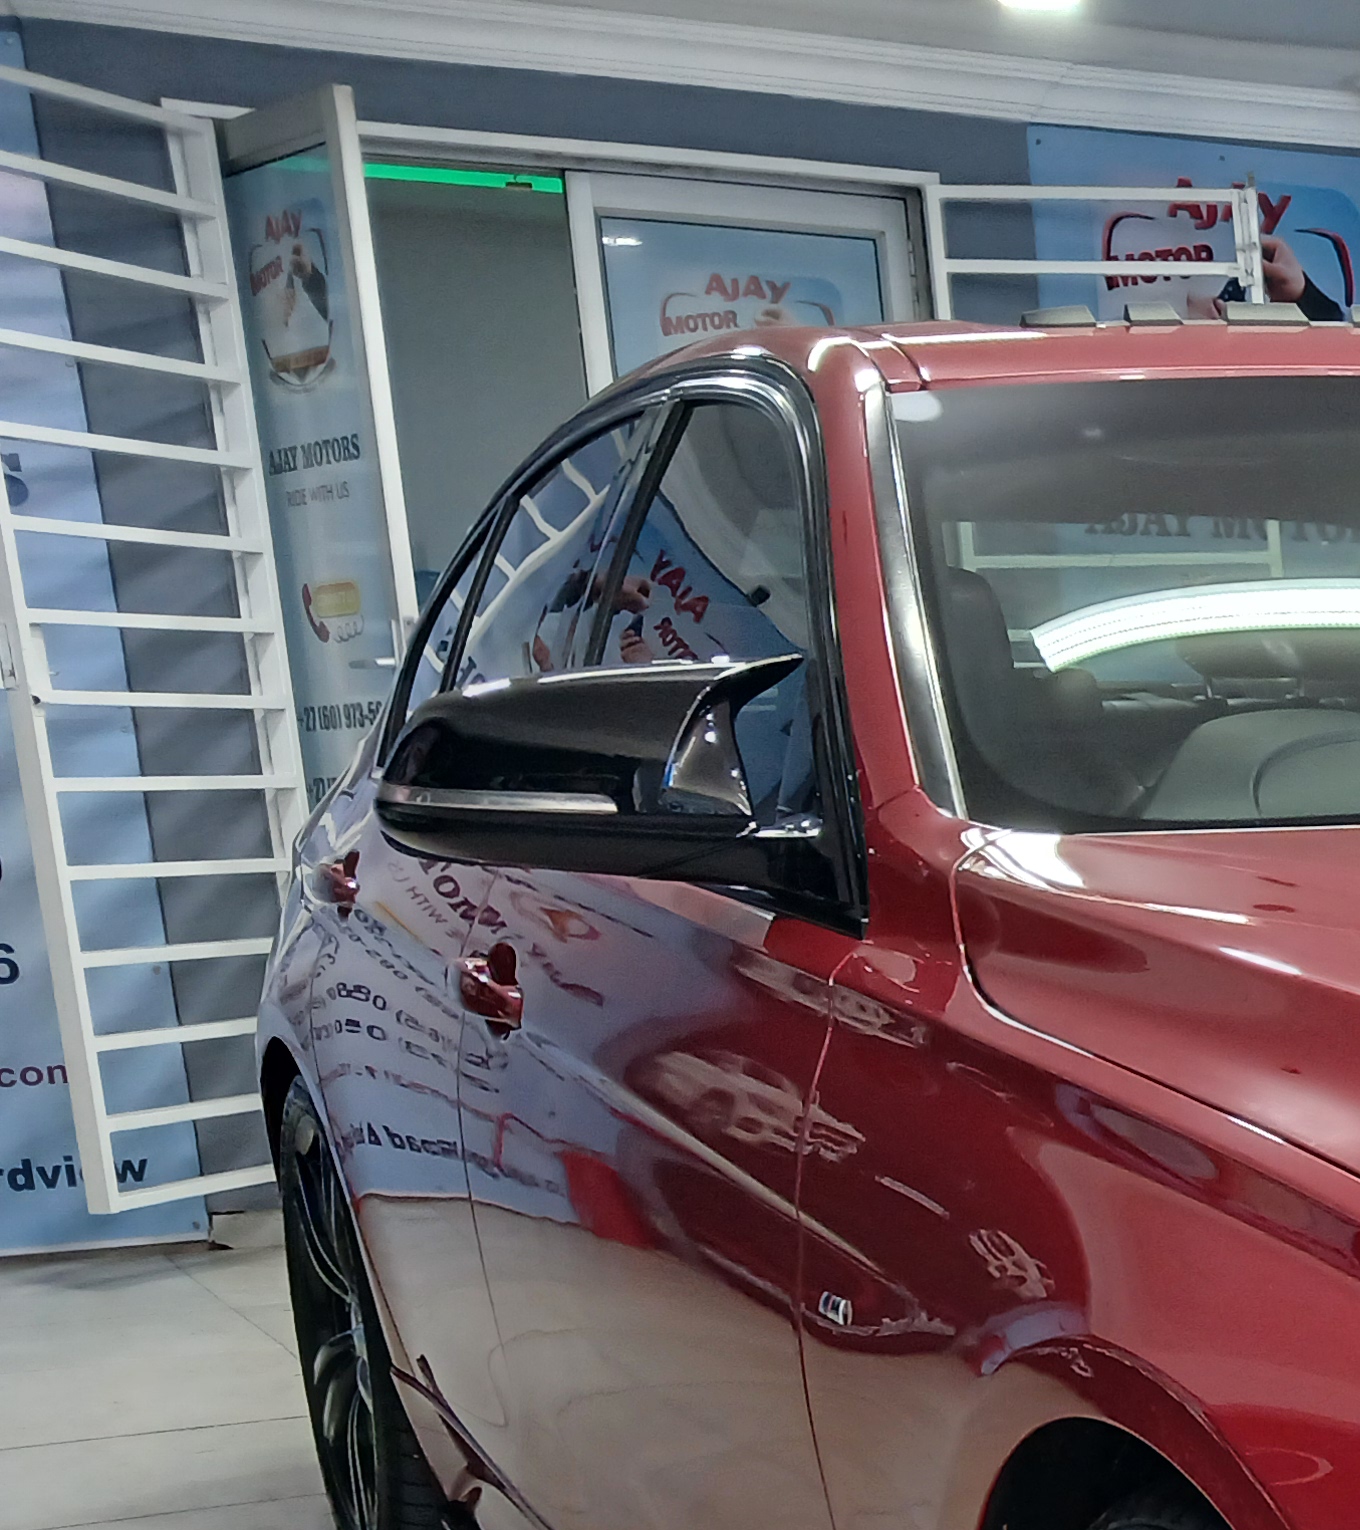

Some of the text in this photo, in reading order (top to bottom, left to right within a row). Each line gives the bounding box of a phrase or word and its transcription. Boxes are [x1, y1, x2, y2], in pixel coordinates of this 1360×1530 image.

[704, 272, 792, 304] AJAY
[661, 309, 740, 337] MOTOR
[300, 433, 361, 470] MOTORS
